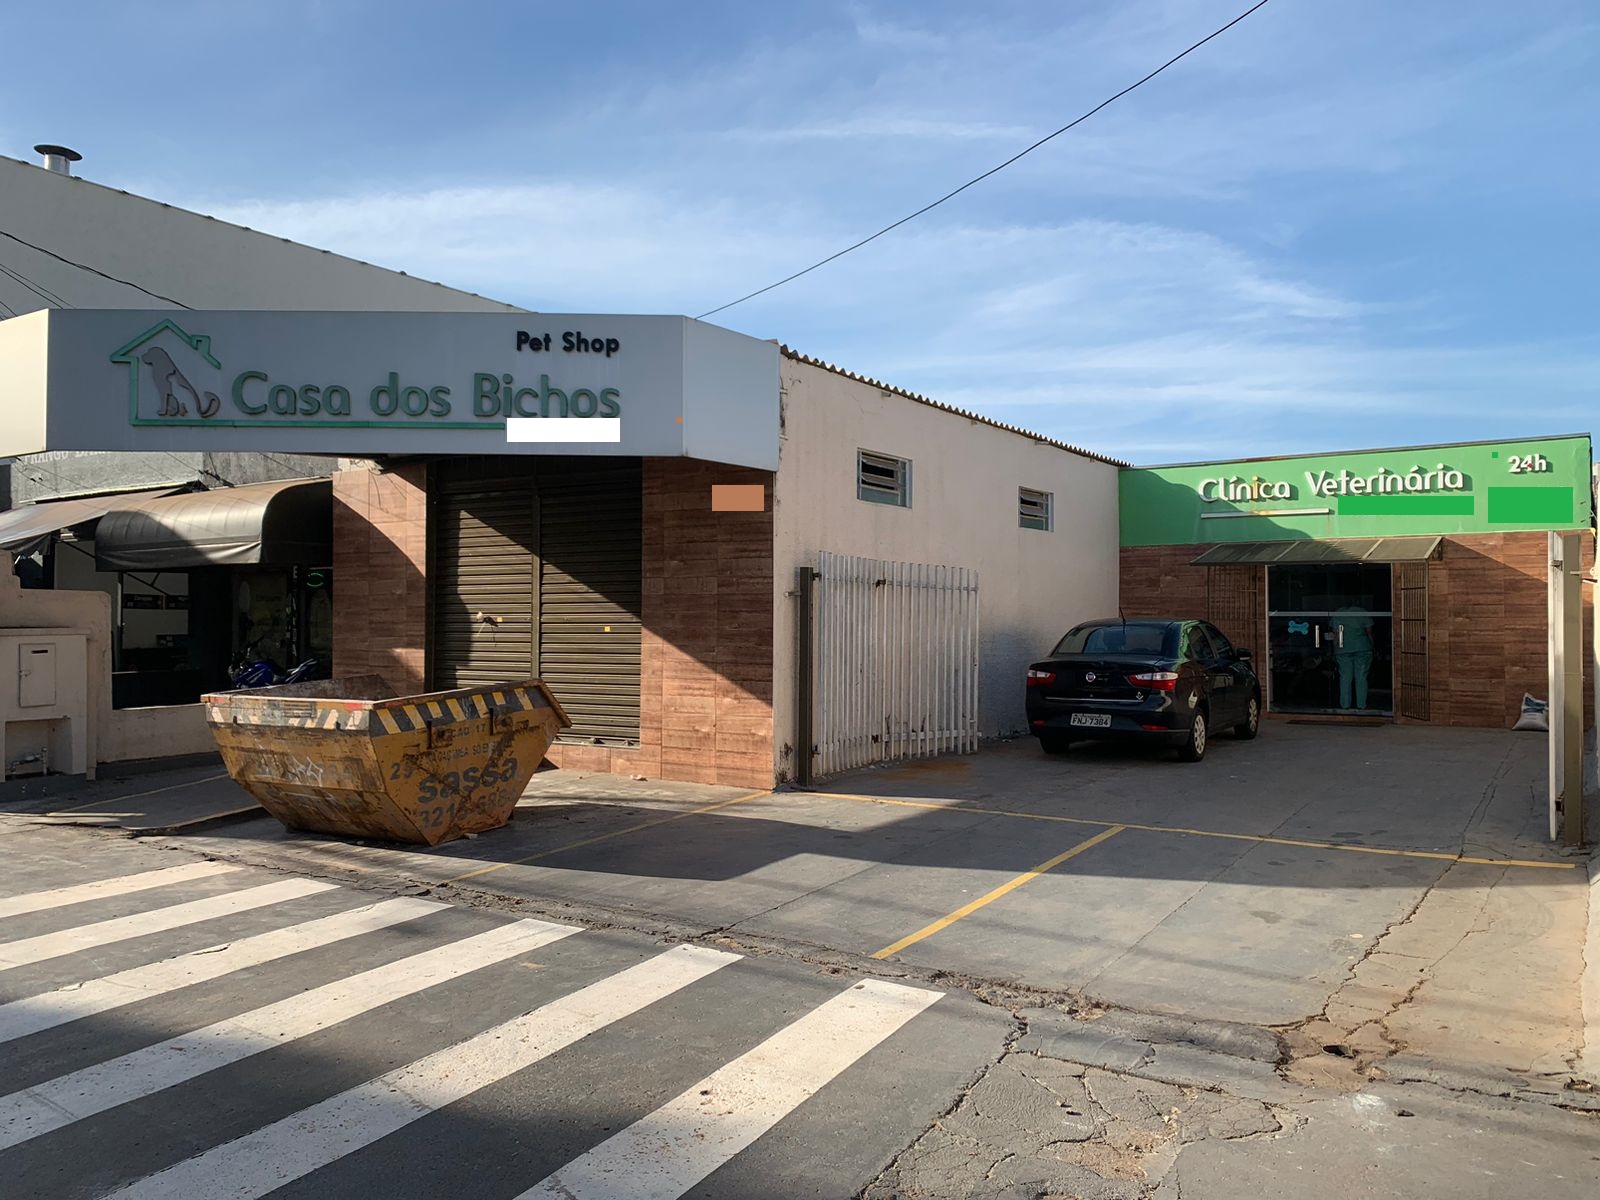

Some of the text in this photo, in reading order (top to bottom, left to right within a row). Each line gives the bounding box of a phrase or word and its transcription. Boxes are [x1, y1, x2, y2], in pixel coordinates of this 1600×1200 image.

[516, 330, 621, 358] Pet Shop
[231, 371, 622, 419] Casa dos Bichos
[1507, 453, 1548, 474] 24h
[1198, 463, 1465, 503] Clínica Veterinária
